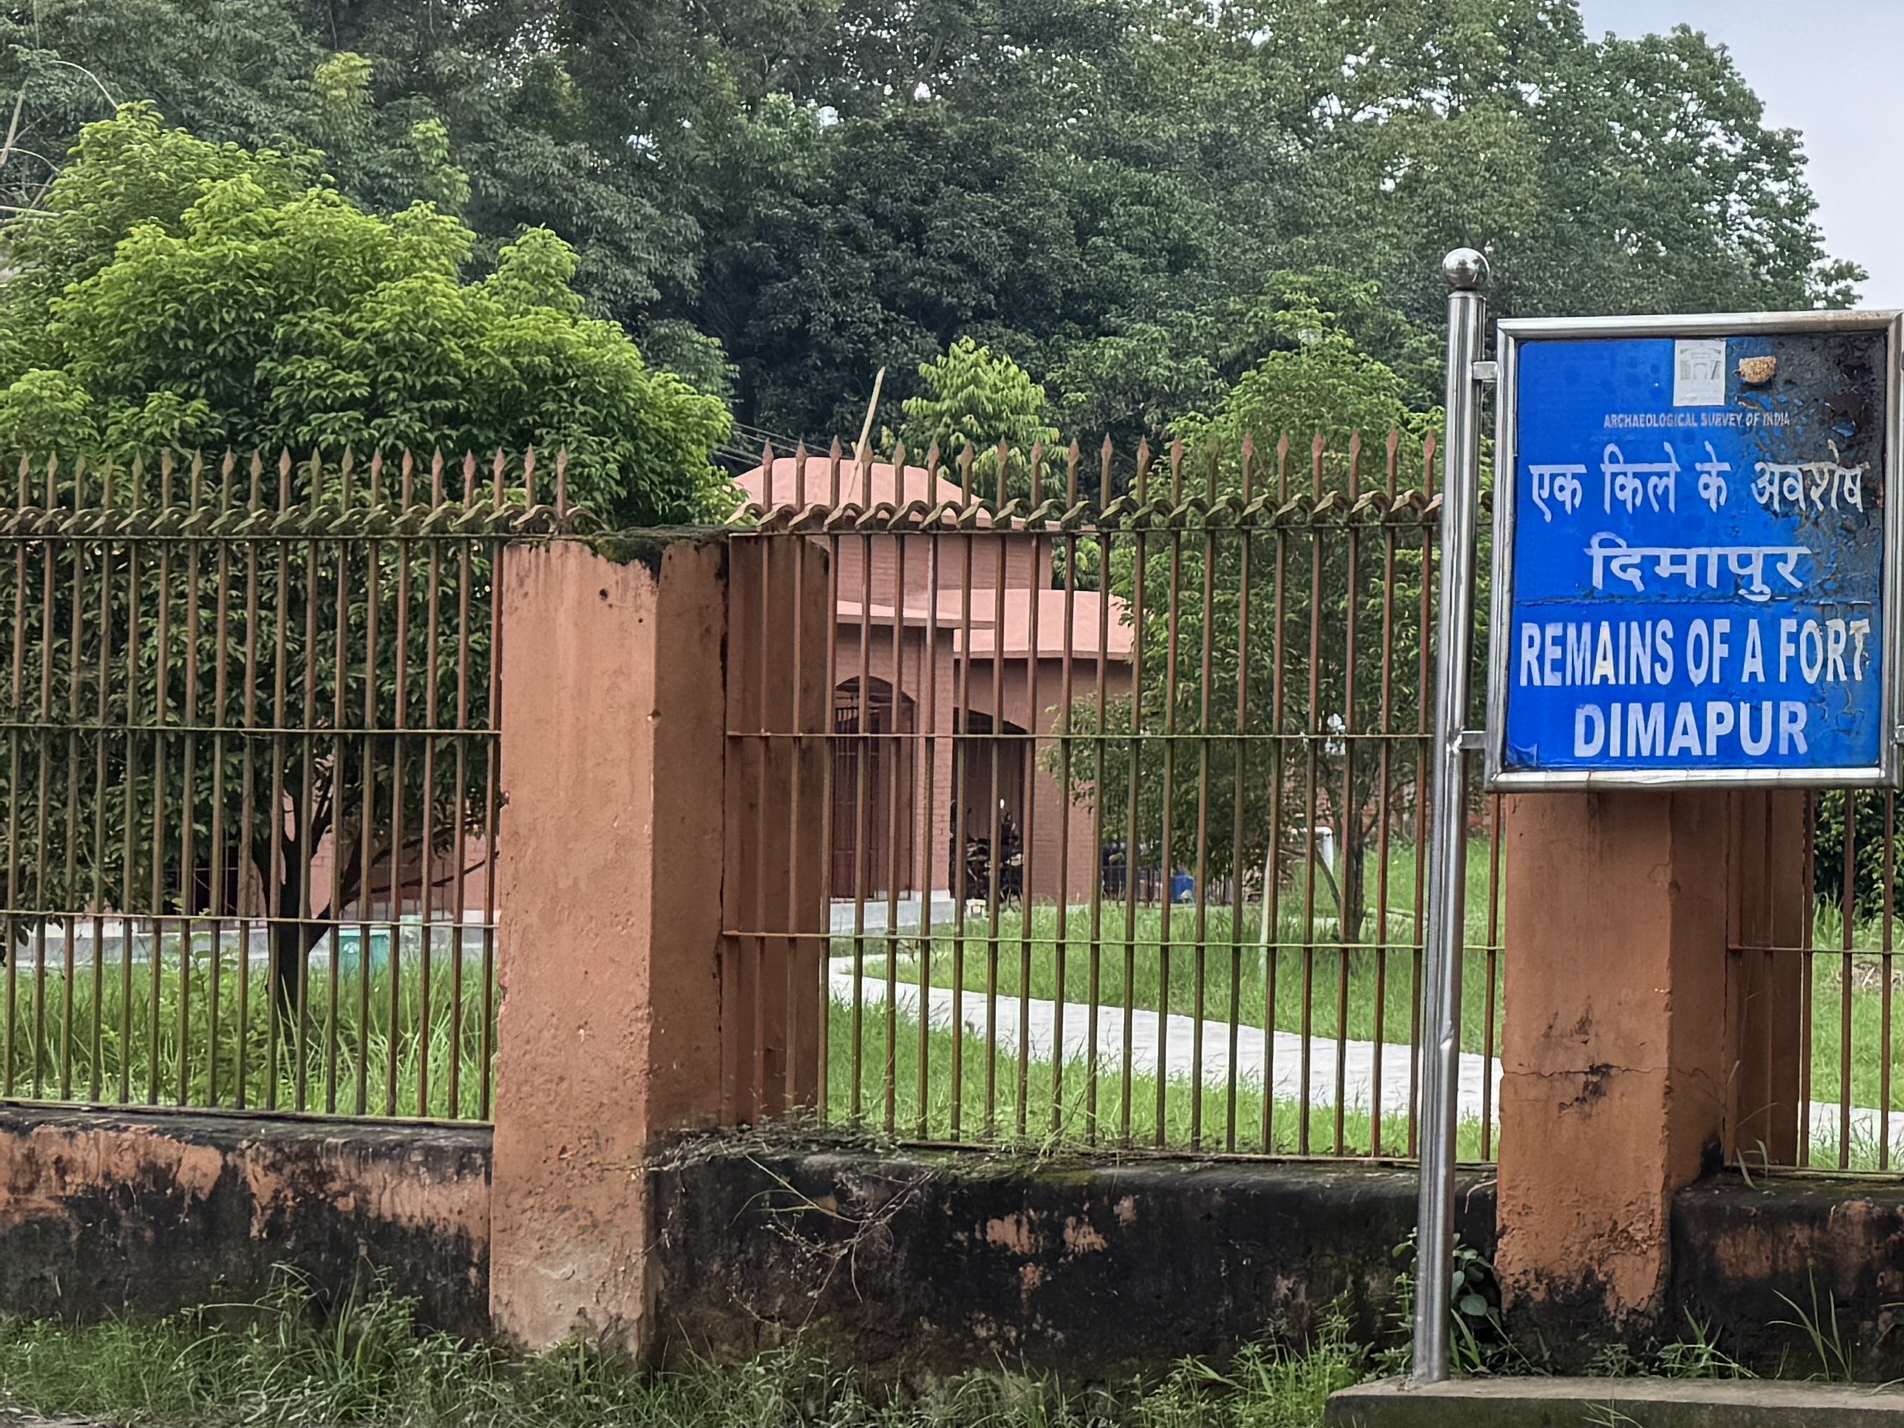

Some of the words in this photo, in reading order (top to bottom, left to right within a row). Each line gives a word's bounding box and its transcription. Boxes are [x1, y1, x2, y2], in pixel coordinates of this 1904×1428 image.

[1604, 414, 1698, 429] ARCHAEOLOGICAL
[1701, 413, 1742, 427] SURVEY
[1745, 413, 1760, 426] OF
[1763, 412, 1791, 426] INDIA
[1528, 464, 1587, 523] एक
[1600, 441, 1681, 515] किले
[1695, 440, 1732, 513] के
[1752, 439, 1871, 513] अवशेष
[1583, 531, 1812, 603] दिमापुर
[1519, 619, 1675, 687] REMAINS
[1686, 618, 1731, 685] OF
[1741, 618, 1766, 684] A
[1779, 617, 1871, 685] FORT
[1573, 701, 1808, 758] DIMAPUR
